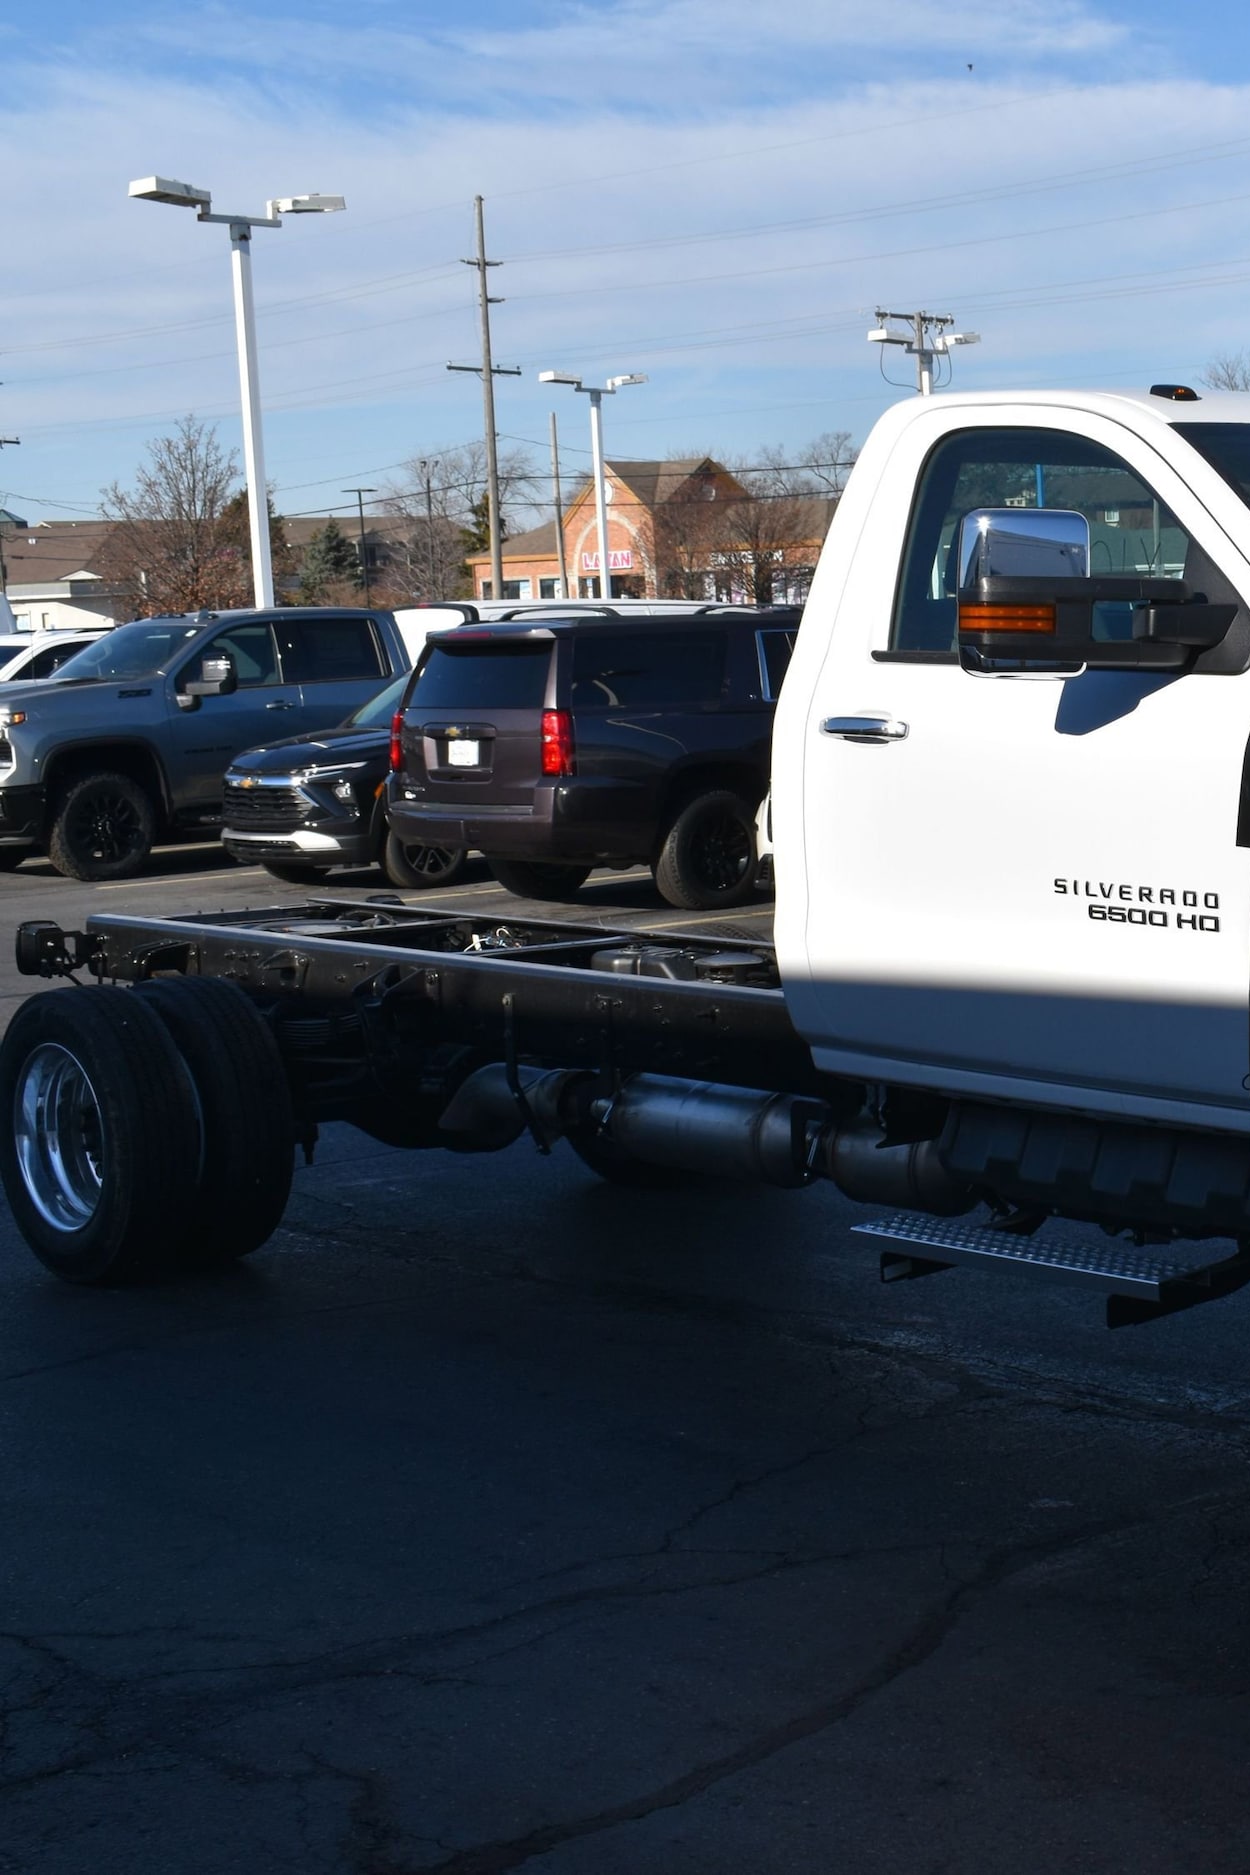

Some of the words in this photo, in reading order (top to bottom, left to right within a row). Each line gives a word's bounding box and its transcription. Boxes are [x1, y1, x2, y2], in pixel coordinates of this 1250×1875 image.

[1054, 878, 1220, 909] SILVERADO
[1088, 904, 1168, 927] 6500
[1176, 913, 1220, 932] HD
